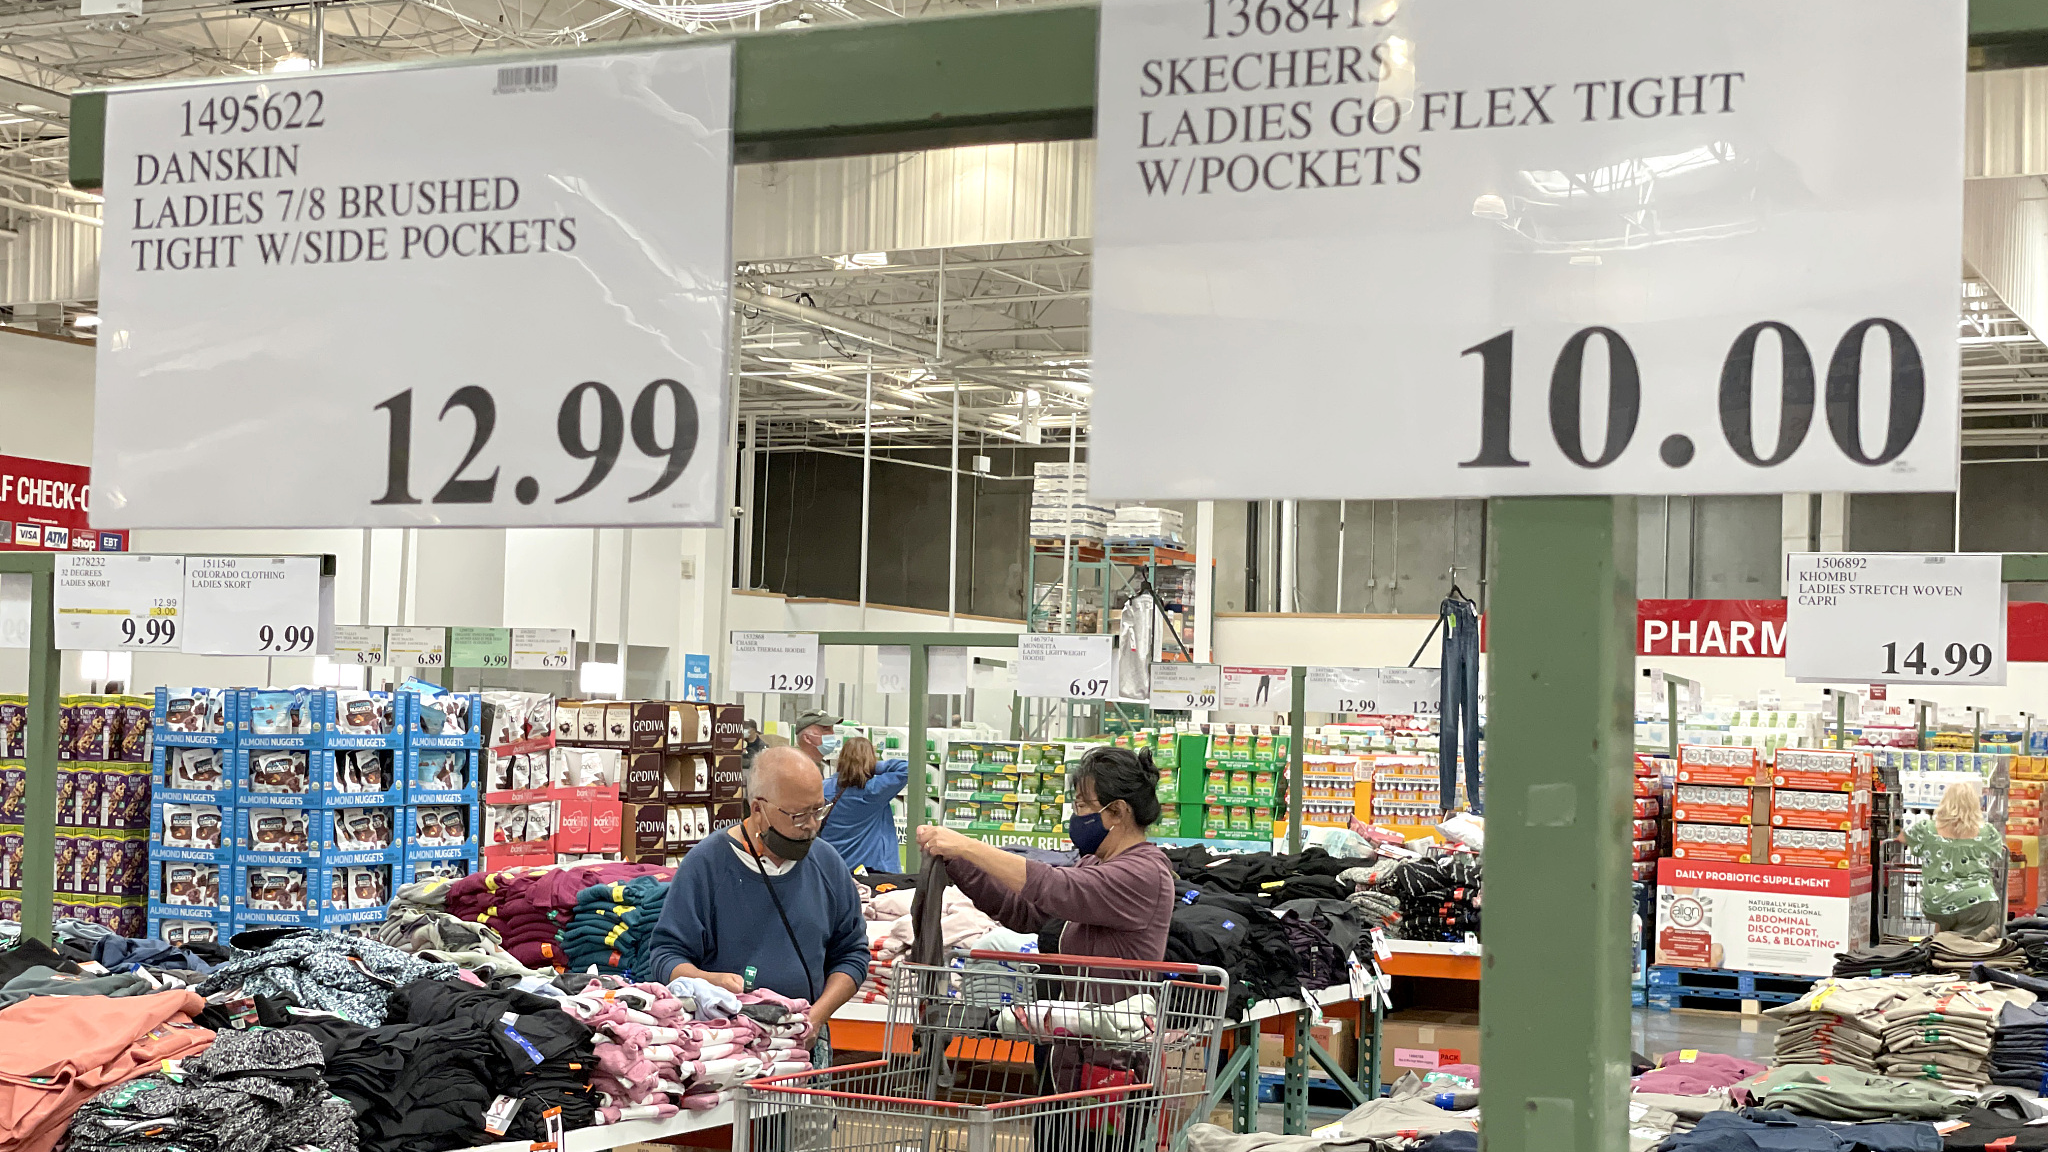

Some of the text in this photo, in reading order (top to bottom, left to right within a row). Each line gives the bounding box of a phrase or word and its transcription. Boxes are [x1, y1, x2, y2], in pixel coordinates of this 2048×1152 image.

[1203, 0, 1396, 39] 136841
[1140, 42, 1393, 98] SKECHERS
[181, 89, 325, 137] 1495622
[1137, 71, 1746, 148] LADIES GO FLEX TIGHT
[134, 144, 300, 187] DANSKIN
[1136, 144, 1422, 197] W/POCKETS
[132, 176, 520, 230] LADIES 7/8 BRUSHED
[131, 217, 577, 272] TIGHT W/SIDE POCKETS
[1457, 317, 1926, 470] 10.00
[371, 377, 700, 507] 12.99
[20, 529, 37, 540] VISA
[46, 531, 67, 544] ATM
[72, 537, 96, 551] shop
[103, 537, 118, 547] EBT
[71, 557, 106, 567] 1278232
[202, 559, 236, 568] 1511540
[1815, 557, 1867, 569] 1506892
[70, 569, 102, 577] DEGREES
[192, 570, 285, 580] COLORADO CLOTHING
[1799, 571, 1857, 582] KHOMBU
[61, 579, 86, 587] LADIES
[192, 580, 251, 589] LADIES SKORT
[1799, 583, 1963, 596] LADIES STRETCH WOVEN
[154, 598, 177, 607] 12.99
[1798, 595, 1837, 606] CAPRI
[121, 618, 176, 645] 9.99
[1643, 619, 1787, 655] PHARM
[258, 625, 315, 652] 9.99
[357, 652, 381, 664] 8.79
[418, 653, 442, 664] 6.89
[483, 655, 508, 666] 9.99
[543, 655, 567, 667] 6.79
[1881, 641, 1992, 677] 14.99
[769, 674, 814, 691] 12.99
[1070, 678, 1108, 697] 6.97
[1186, 694, 1216, 707] 9.99
[1338, 699, 1376, 712] 12.99
[633, 720, 665, 732] GODIVA
[715, 722, 744, 734] GODIVA
[155, 734, 218, 744] ALMOND NUGGETS
[239, 738, 304, 746] ALMOND NUGGETS
[328, 738, 386, 747] ALMOND NUGGETS
[411, 738, 464, 746] ALMOND NUGGETS
[629, 770, 660, 783] GODIVA
[714, 771, 743, 783] GODIVA
[153, 792, 216, 802] ALMOND NUGGETS
[239, 795, 303, 805] ALMOND NUGGETS
[325, 795, 384, 805] ALMOND NUGGETS
[410, 794, 462, 803] ALMOND NUGGETS
[635, 820, 665, 833] GODIVA
[981, 834, 1034, 848] ALLERGY
[151, 849, 214, 860] ALMOND NUGGETS
[238, 854, 302, 864] ALMOND NUGGETS
[325, 853, 384, 864] ALMOND NUGGETS
[408, 849, 462, 859] ALMOND NUGGETS
[1675, 869, 1831, 888] DAILY PROBIOTIC SUPPLEMENT
[1748, 899, 1787, 908] NATURALLY
[149, 907, 213, 918] ALMOND NUGGETS
[235, 912, 300, 923] ALMOND NUGGETS
[323, 911, 383, 923] ALMOND NUGGETS
[1672, 903, 1700, 921] align
[1748, 906, 1822, 917] SOOTHE OCCASIONAL
[1748, 914, 1811, 926] ABDOMINAL
[1748, 924, 1819, 938] DISCOMFORT,
[1748, 934, 1771, 945] GAS,
[1773, 936, 1781, 944] &
[1440, 1053, 1459, 1061] PACK
